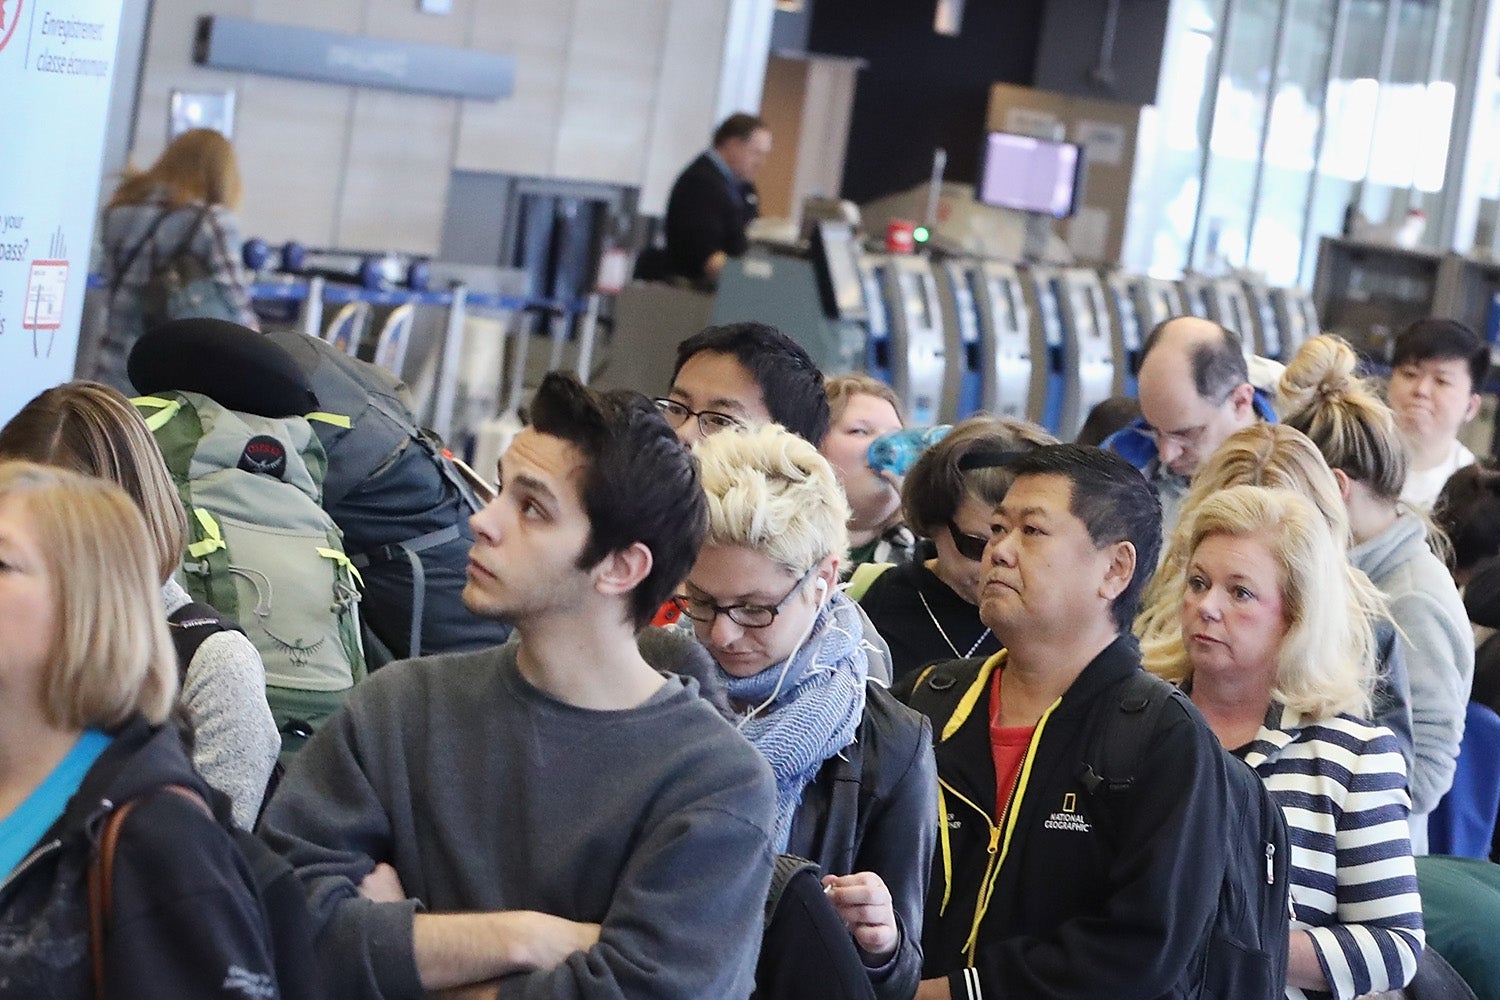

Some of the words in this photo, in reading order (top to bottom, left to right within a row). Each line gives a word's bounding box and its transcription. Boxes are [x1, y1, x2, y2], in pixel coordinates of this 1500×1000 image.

[36, 47, 67, 74] classe
[2, 215, 25, 234] your
[1050, 812, 1085, 824] NATIONAL
[1044, 820, 1091, 833] GEOGRAPHIC
